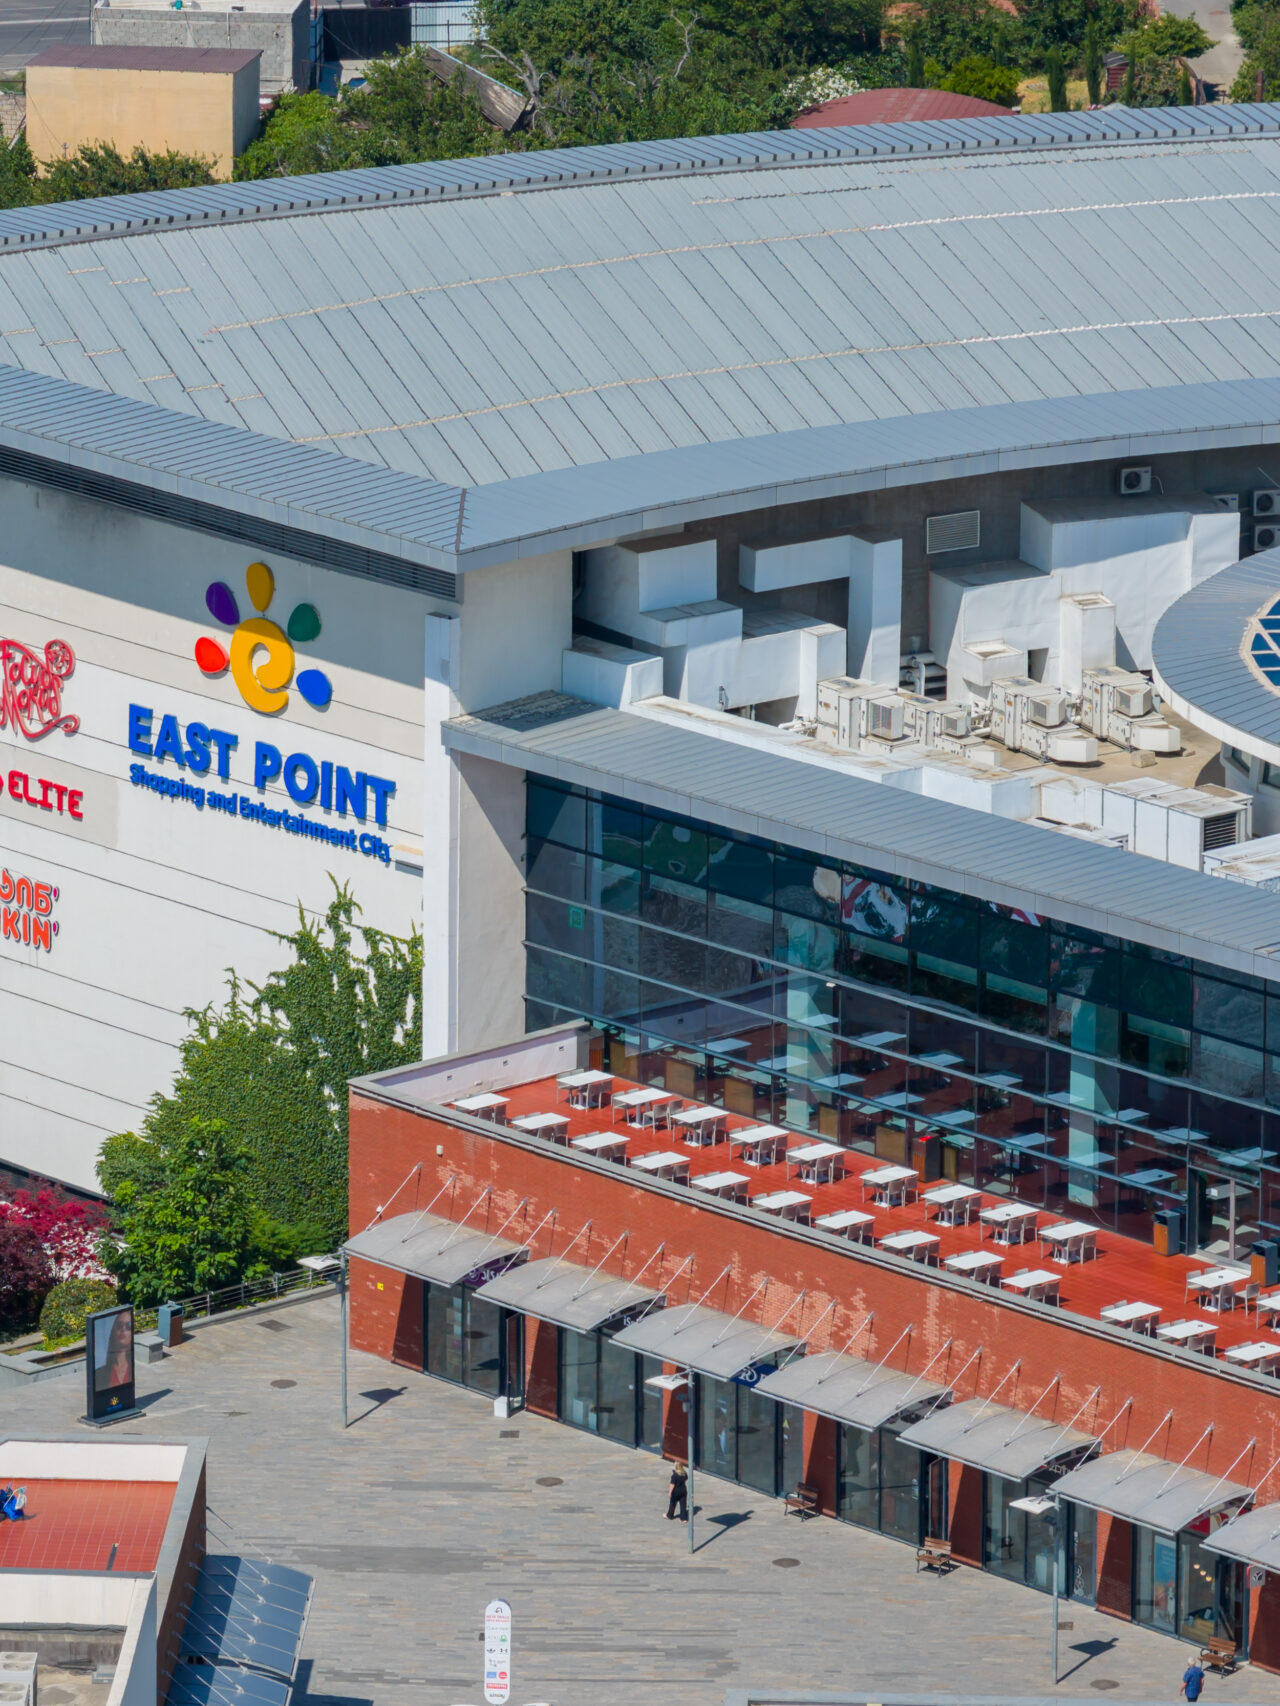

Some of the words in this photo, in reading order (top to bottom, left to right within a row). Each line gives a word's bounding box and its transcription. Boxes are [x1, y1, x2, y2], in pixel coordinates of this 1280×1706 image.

[8, 770, 83, 818] ELITE
[129, 703, 239, 779] EAST
[254, 741, 397, 826] POINT
[129, 763, 206, 808] Shopping
[207, 791, 238, 813] and
[239, 796, 358, 850] Entertainment
[359, 832, 391, 863] City
